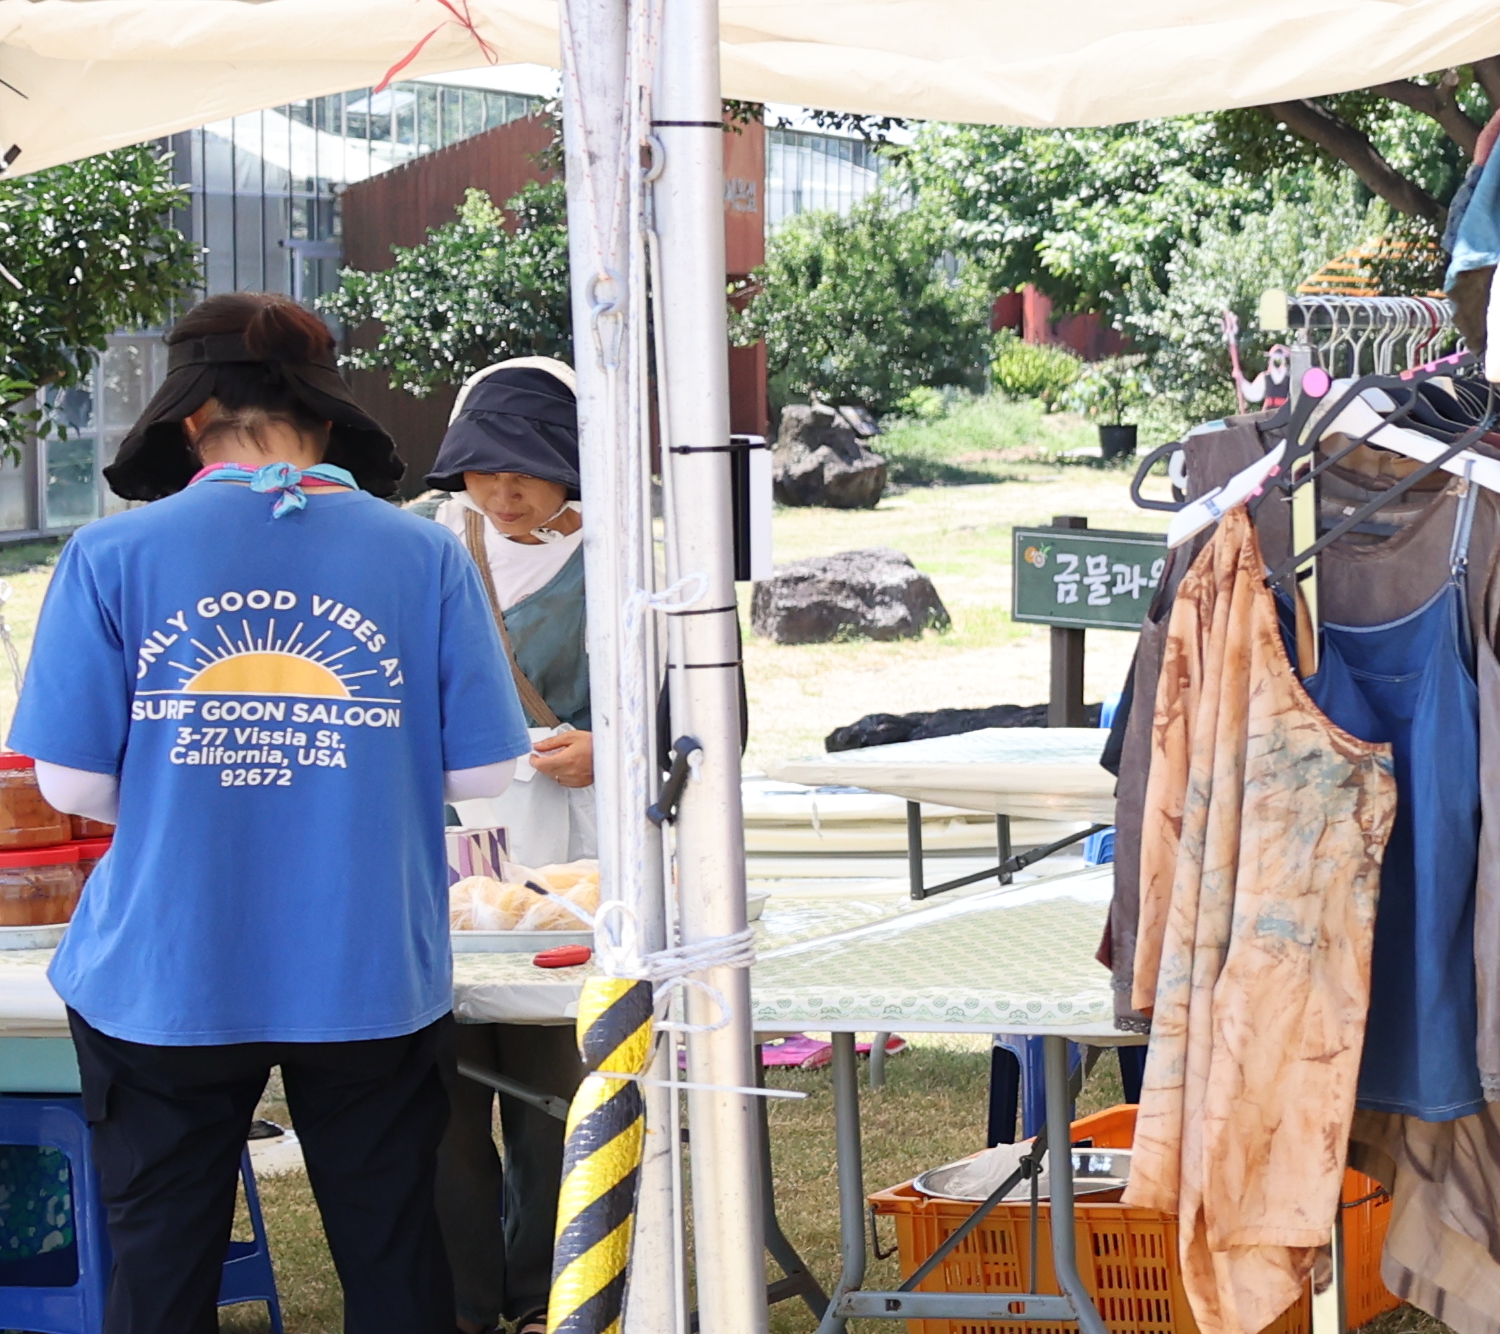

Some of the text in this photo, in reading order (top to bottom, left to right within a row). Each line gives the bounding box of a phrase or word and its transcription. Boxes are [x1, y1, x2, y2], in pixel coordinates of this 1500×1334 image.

[197, 590, 297, 618] GOOD
[311, 595, 386, 653] VIBES
[379, 657, 404, 687] AT
[131, 700, 401, 728] SURF GOON SALOON
[177, 727, 347, 749] 3-77 Vissia St.
[170, 746, 348, 769] California, USA
[220, 769, 293, 787] 92672
